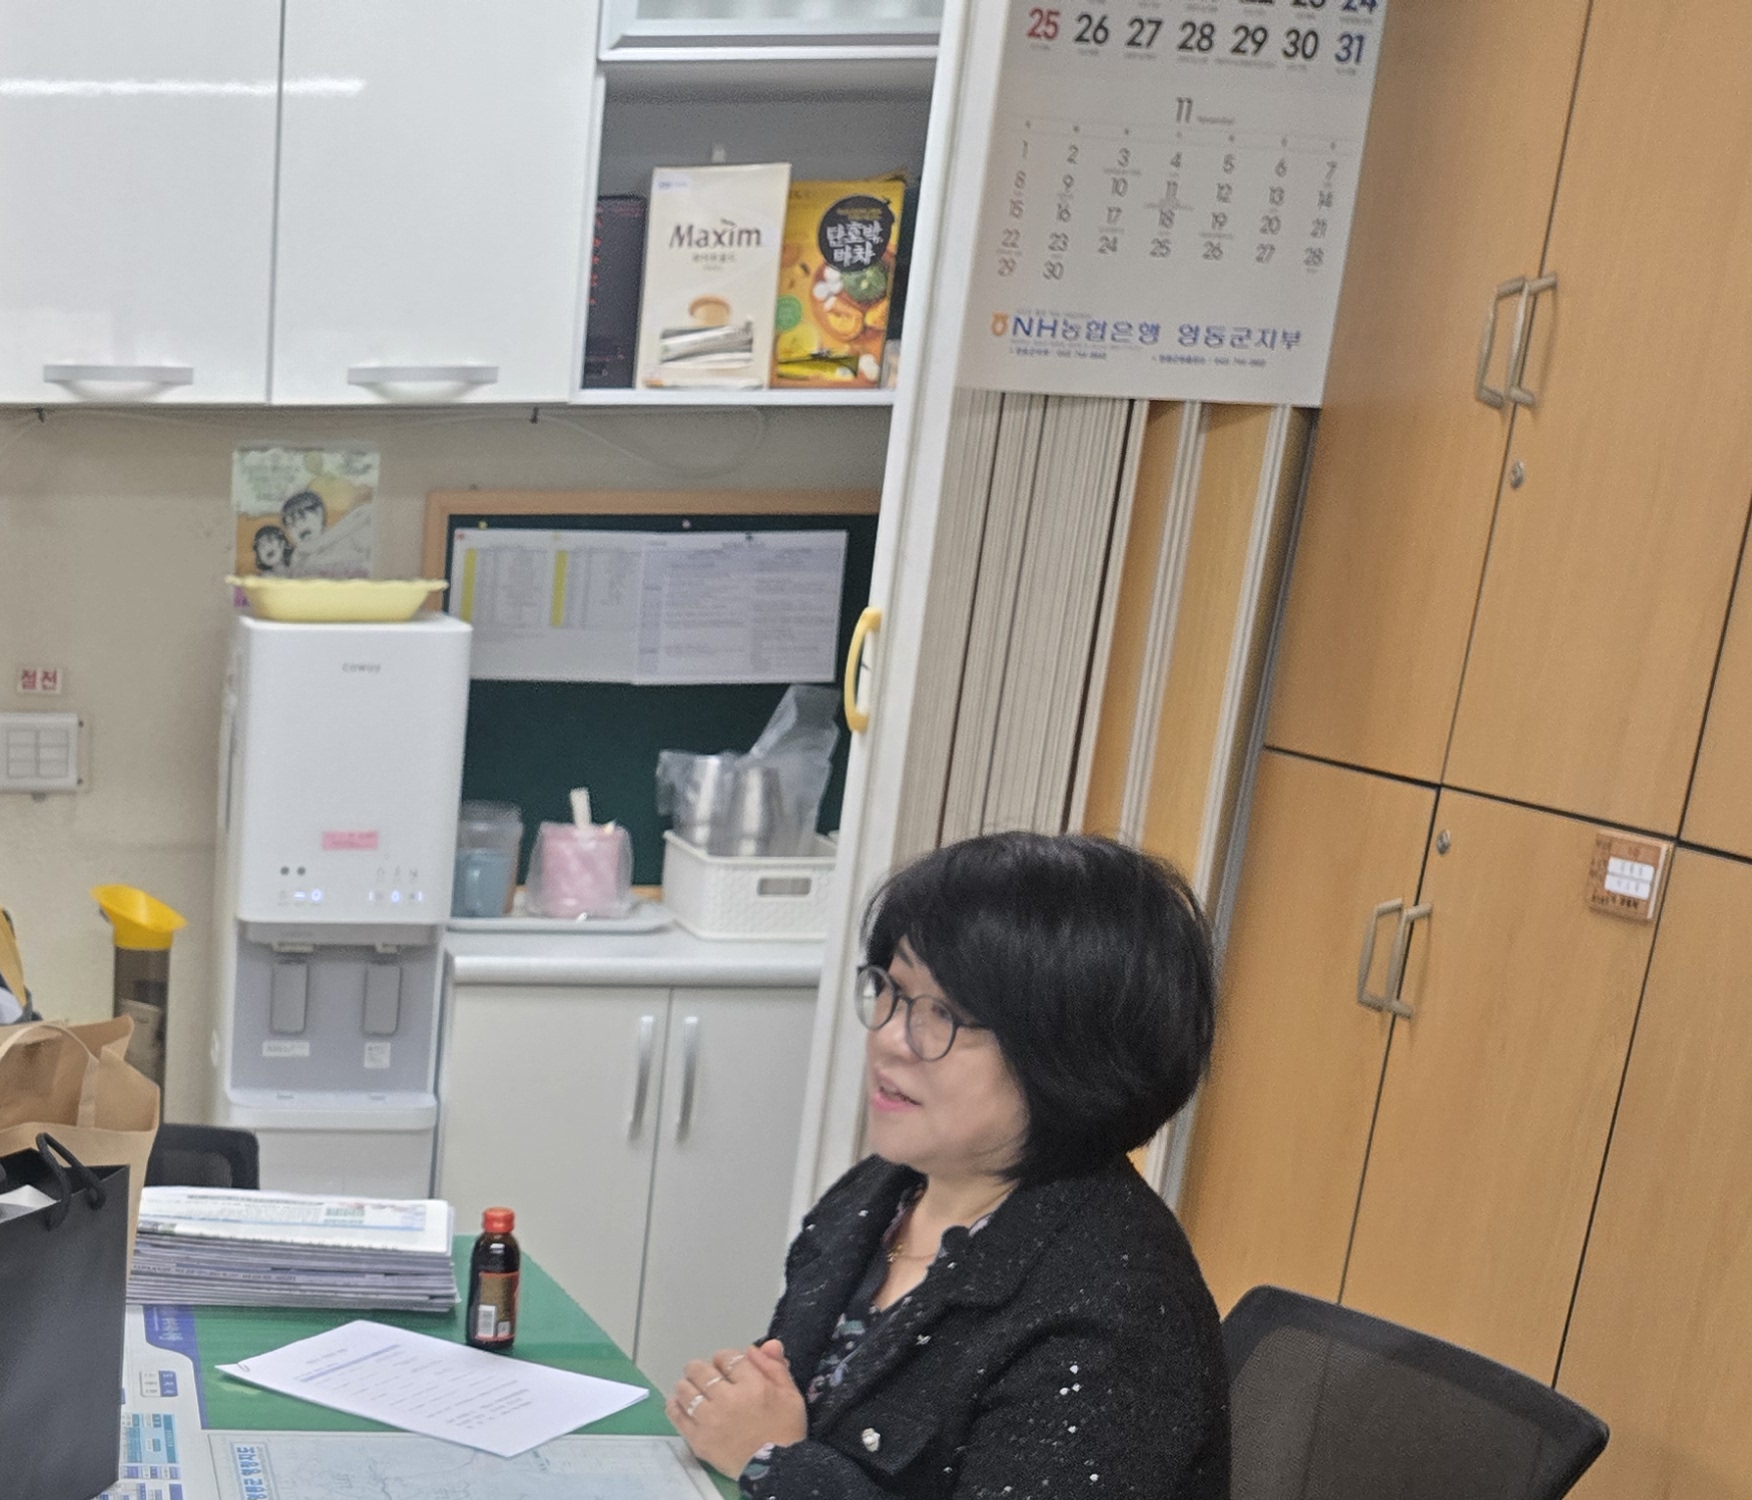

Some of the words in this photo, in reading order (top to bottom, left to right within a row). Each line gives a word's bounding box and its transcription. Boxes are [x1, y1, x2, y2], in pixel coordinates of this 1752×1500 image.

[1027, 8, 1059, 39] 25
[1074, 14, 1109, 44] 26
[1127, 18, 1163, 47] 27
[1178, 21, 1215, 51] 28
[1231, 25, 1268, 55] 29
[1283, 29, 1319, 59] 30
[1335, 33, 1365, 64] 31
[1175, 98, 1193, 123] 11
[1022, 140, 1029, 159] 1
[1067, 145, 1079, 164] 2
[1118, 148, 1130, 167] 3
[1170, 152, 1182, 168] 4
[1222, 154, 1235, 174] 5
[1274, 158, 1287, 177] 6
[1326, 161, 1337, 179] 7
[1014, 170, 1026, 188] 8
[1062, 173, 1074, 190] 9
[1111, 177, 1128, 197] 10
[1166, 180, 1178, 199] 11
[1217, 183, 1233, 202] 12
[669, 218, 762, 249] Maxim
[1056, 203, 1071, 223] 16
[1107, 206, 1122, 225] 17
[1211, 211, 1228, 230] 19
[1260, 215, 1281, 235] 20
[1311, 218, 1327, 239] 21
[1001, 228, 1020, 248] 22
[1048, 232, 1069, 252] 23
[1099, 236, 1118, 254] 24
[1150, 238, 1171, 258] 25
[1203, 241, 1224, 261] 26
[1255, 243, 1275, 263] 27
[1043, 260, 1064, 280] 30
[1012, 316, 1160, 346] NH농협은행
[1178, 323, 1302, 350] 영동군지부
